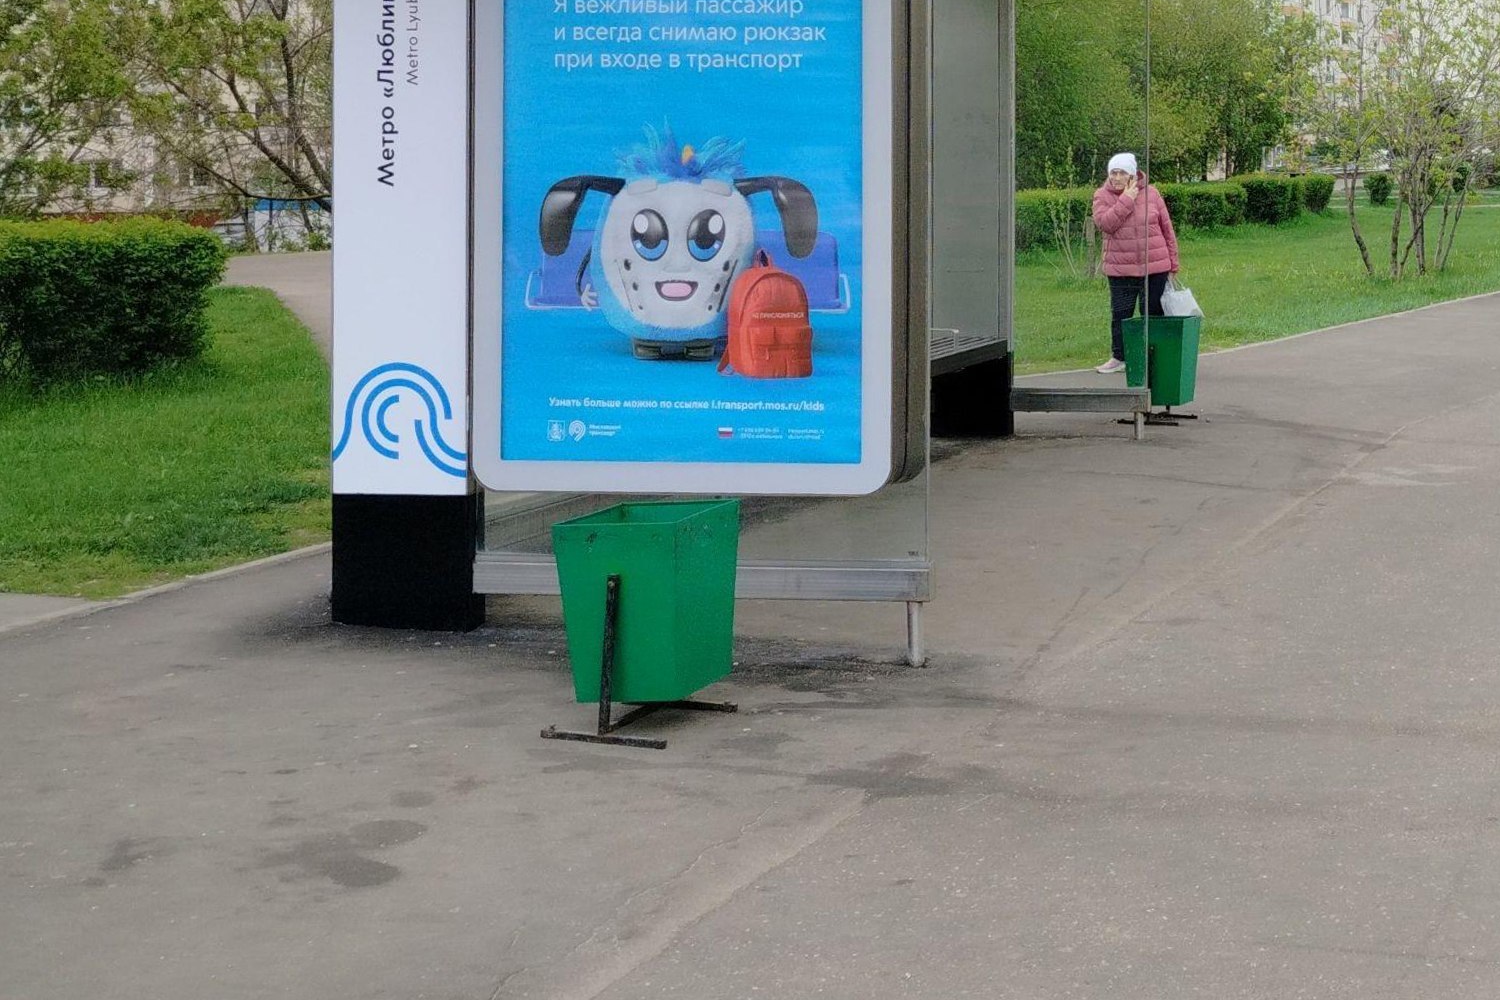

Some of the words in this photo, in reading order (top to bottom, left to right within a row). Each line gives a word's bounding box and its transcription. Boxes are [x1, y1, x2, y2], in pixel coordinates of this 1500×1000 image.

[554, 26, 566, 41] и
[573, 26, 642, 43] всегда
[649, 25, 737, 42] снимаю
[744, 26, 827, 45] рюкзак
[406, 35, 419, 86] Metro
[554, 53, 593, 73] при
[600, 53, 662, 70] входе
[669, 53, 681, 69] в
[687, 52, 804, 73] транспорт
[377, 105, 399, 187] Метро
[548, 397, 581, 407] Узнать
[583, 397, 621, 408] больше
[623, 400, 658, 409] можно
[660, 400, 672, 409] по
[674, 400, 709, 409] ссылке
